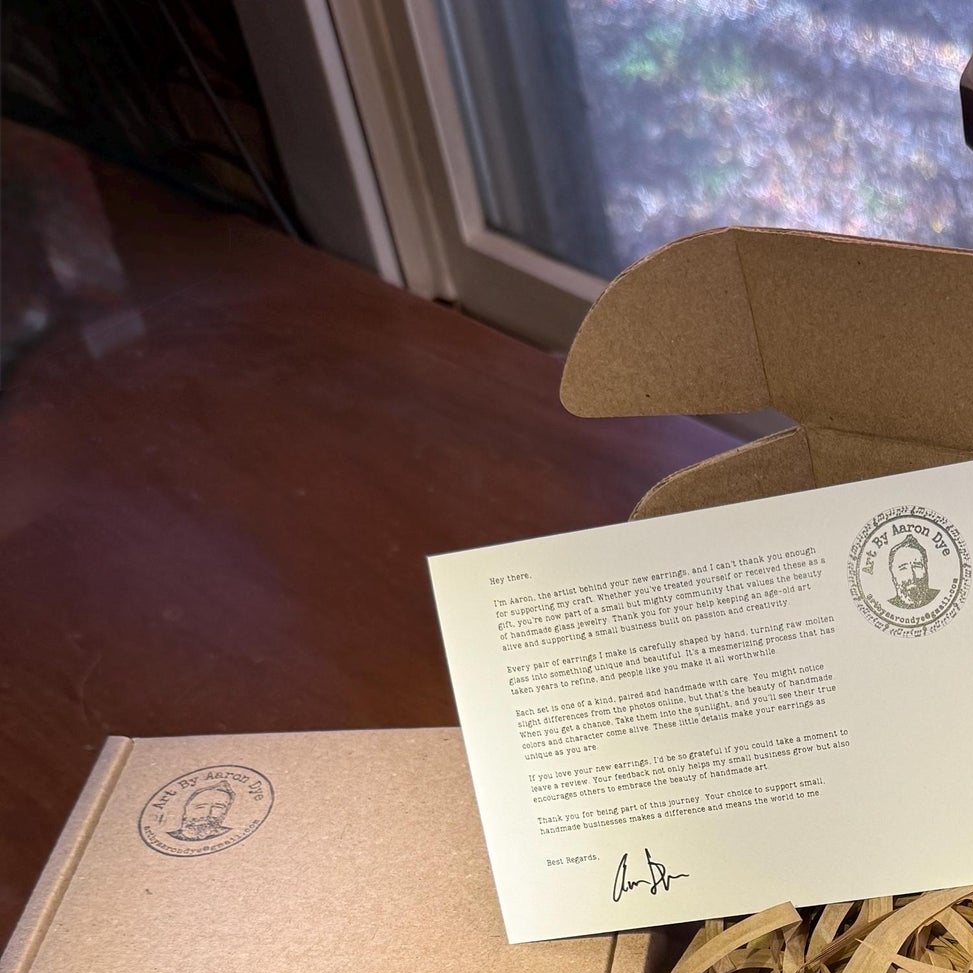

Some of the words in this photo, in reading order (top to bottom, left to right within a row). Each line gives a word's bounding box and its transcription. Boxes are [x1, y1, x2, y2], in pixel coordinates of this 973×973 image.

[537, 592, 552, 600] the
[553, 587, 578, 598] artist
[578, 581, 608, 594] behind
[609, 578, 630, 590] your
[631, 575, 649, 585] new
[691, 564, 708, 575] and
[709, 563, 714, 572] I
[738, 555, 765, 567] thank
[766, 553, 783, 564] you
[784, 546, 817, 559] enough
[862, 550, 877, 575] Art
[872, 532, 889, 550] By
[892, 524, 931, 538] Aaron
[931, 531, 951, 557] Dye
[488, 576, 505, 586] Hey
[544, 613, 562, 622] now
[563, 609, 582, 621] part
[583, 606, 592, 616] of
[600, 601, 625, 613] small
[625, 599, 642, 609] but
[642, 594, 673, 606] mighty
[675, 586, 724, 601] community
[725, 582, 745, 592] that
[745, 577, 775, 589] values
[776, 575, 791, 584] the
[792, 569, 822, 581] beauty
[506, 664, 531, 674] Every
[532, 661, 550, 672] pair
[551, 658, 560, 667] of
[561, 653, 598, 666] earrings
[598, 651, 603, 660] I
[604, 648, 628, 659] make
[628, 647, 638, 655] is
[638, 640, 677, 653] carefully
[678, 634, 709, 647] shaped
[710, 633, 722, 642] by
[749, 622, 785, 635] turning
[785, 620, 802, 629] raw
[804, 615, 835, 627] molten
[518, 730, 543, 739] When
[543, 727, 560, 737] you
[560, 724, 575, 735] get
[614, 715, 635, 725] Take
[635, 712, 659, 722] them
[659, 709, 677, 718] into
[677, 707, 693, 716] the
[734, 696, 751, 707] and
[778, 691, 792, 700] see
[793, 688, 816, 698] their
[817, 684, 837, 694] true
[528, 773, 536, 783] If
[537, 773, 554, 783] you
[554, 770, 573, 779] love
[573, 766, 594, 777] your
[594, 764, 612, 773] new
[665, 754, 676, 762] be
[677, 753, 688, 761] so
[688, 746, 723, 761] grateful
[723, 745, 732, 754] if
[733, 744, 750, 754] you
[751, 739, 774, 750] could
[775, 736, 795, 746] take
[803, 730, 838, 742] moment
[839, 729, 849, 737] to
[152, 789, 178, 810] Art
[178, 776, 199, 790] By
[205, 771, 251, 784] Aaron
[248, 780, 265, 802] Dye
[546, 857, 564, 867] Best
